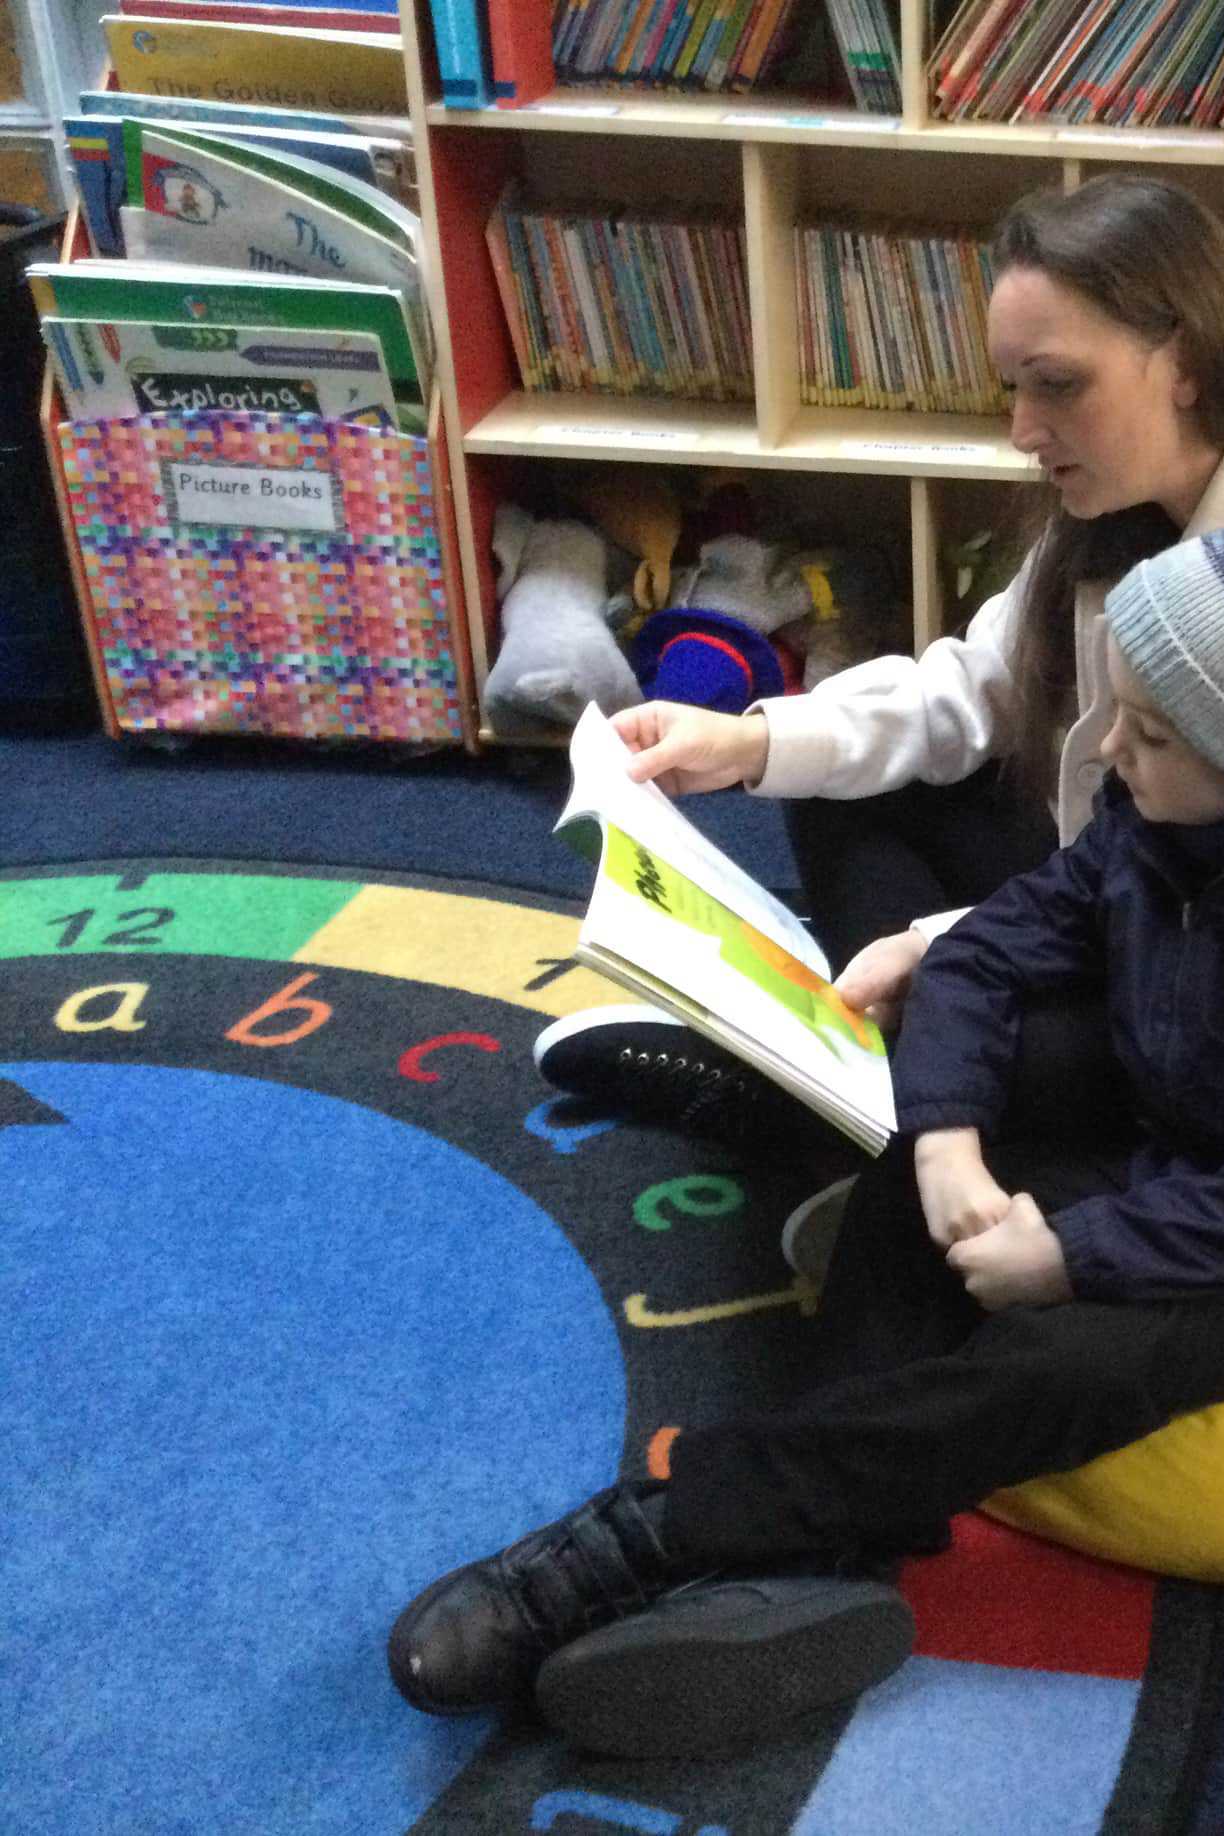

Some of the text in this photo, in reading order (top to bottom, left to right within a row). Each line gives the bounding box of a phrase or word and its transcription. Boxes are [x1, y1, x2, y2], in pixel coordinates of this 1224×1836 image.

[285, 210, 346, 269] The
[141, 378, 302, 412] Exploring
[179, 472, 323, 500] Picture Books
[46, 906, 176, 949] 12
[53, 981, 149, 1033] a
[224, 970, 333, 1047] b
[398, 1030, 501, 1084] c
[632, 1174, 746, 1232] e
